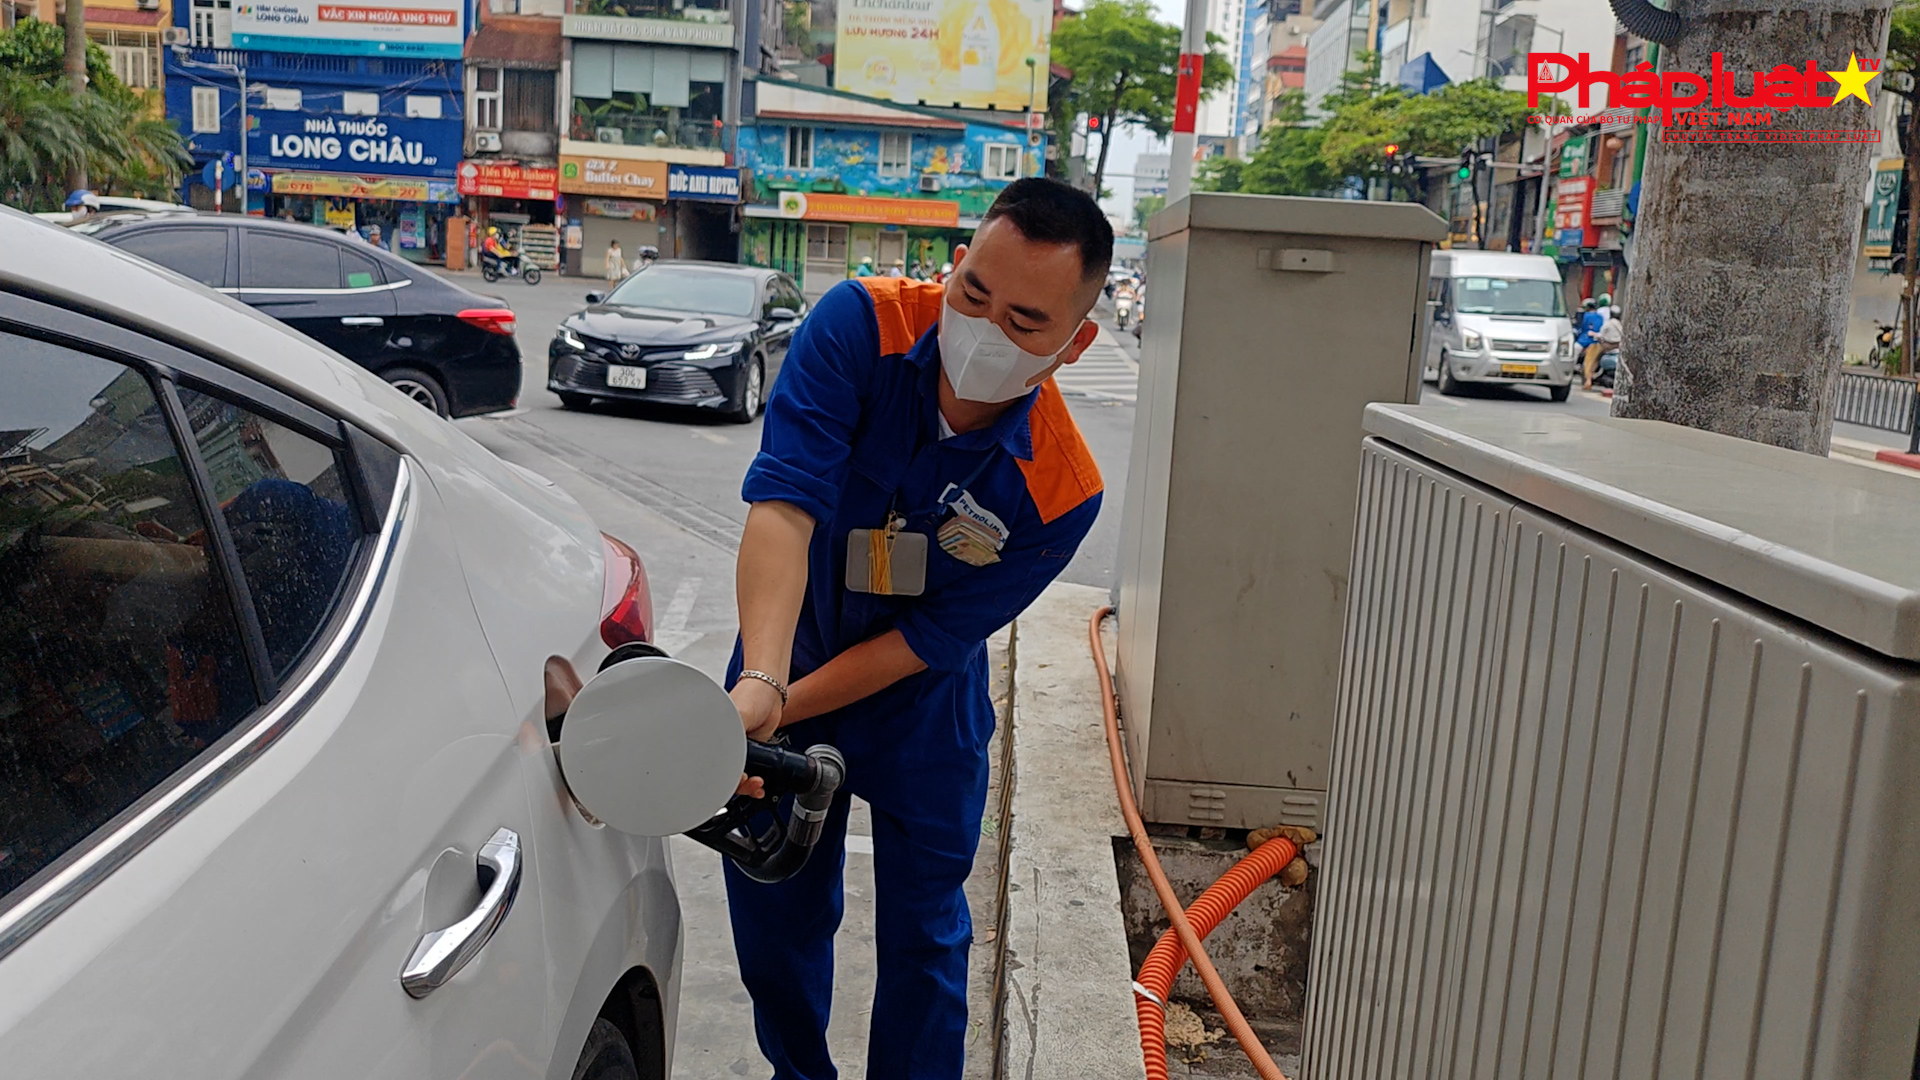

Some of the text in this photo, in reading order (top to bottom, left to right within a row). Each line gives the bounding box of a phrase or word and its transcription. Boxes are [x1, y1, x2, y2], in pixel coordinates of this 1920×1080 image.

[256, 13, 281, 22] LONG
[347, 10, 367, 20] XIN
[368, 9, 400, 22] NGỪA
[402, 12, 425, 23] UNG
[426, 13, 452, 24] THƯ
[911, 27, 940, 40] 24H
[305, 116, 388, 137] NHÀ THUỐC
[270, 134, 342, 159] LONG
[350, 135, 423, 165] CHÂU
[623, 173, 655, 188] Chay
[689, 173, 708, 193] ANH
[709, 174, 739, 195] HOTEL
[959, 498, 1006, 544] PETROLIMX
